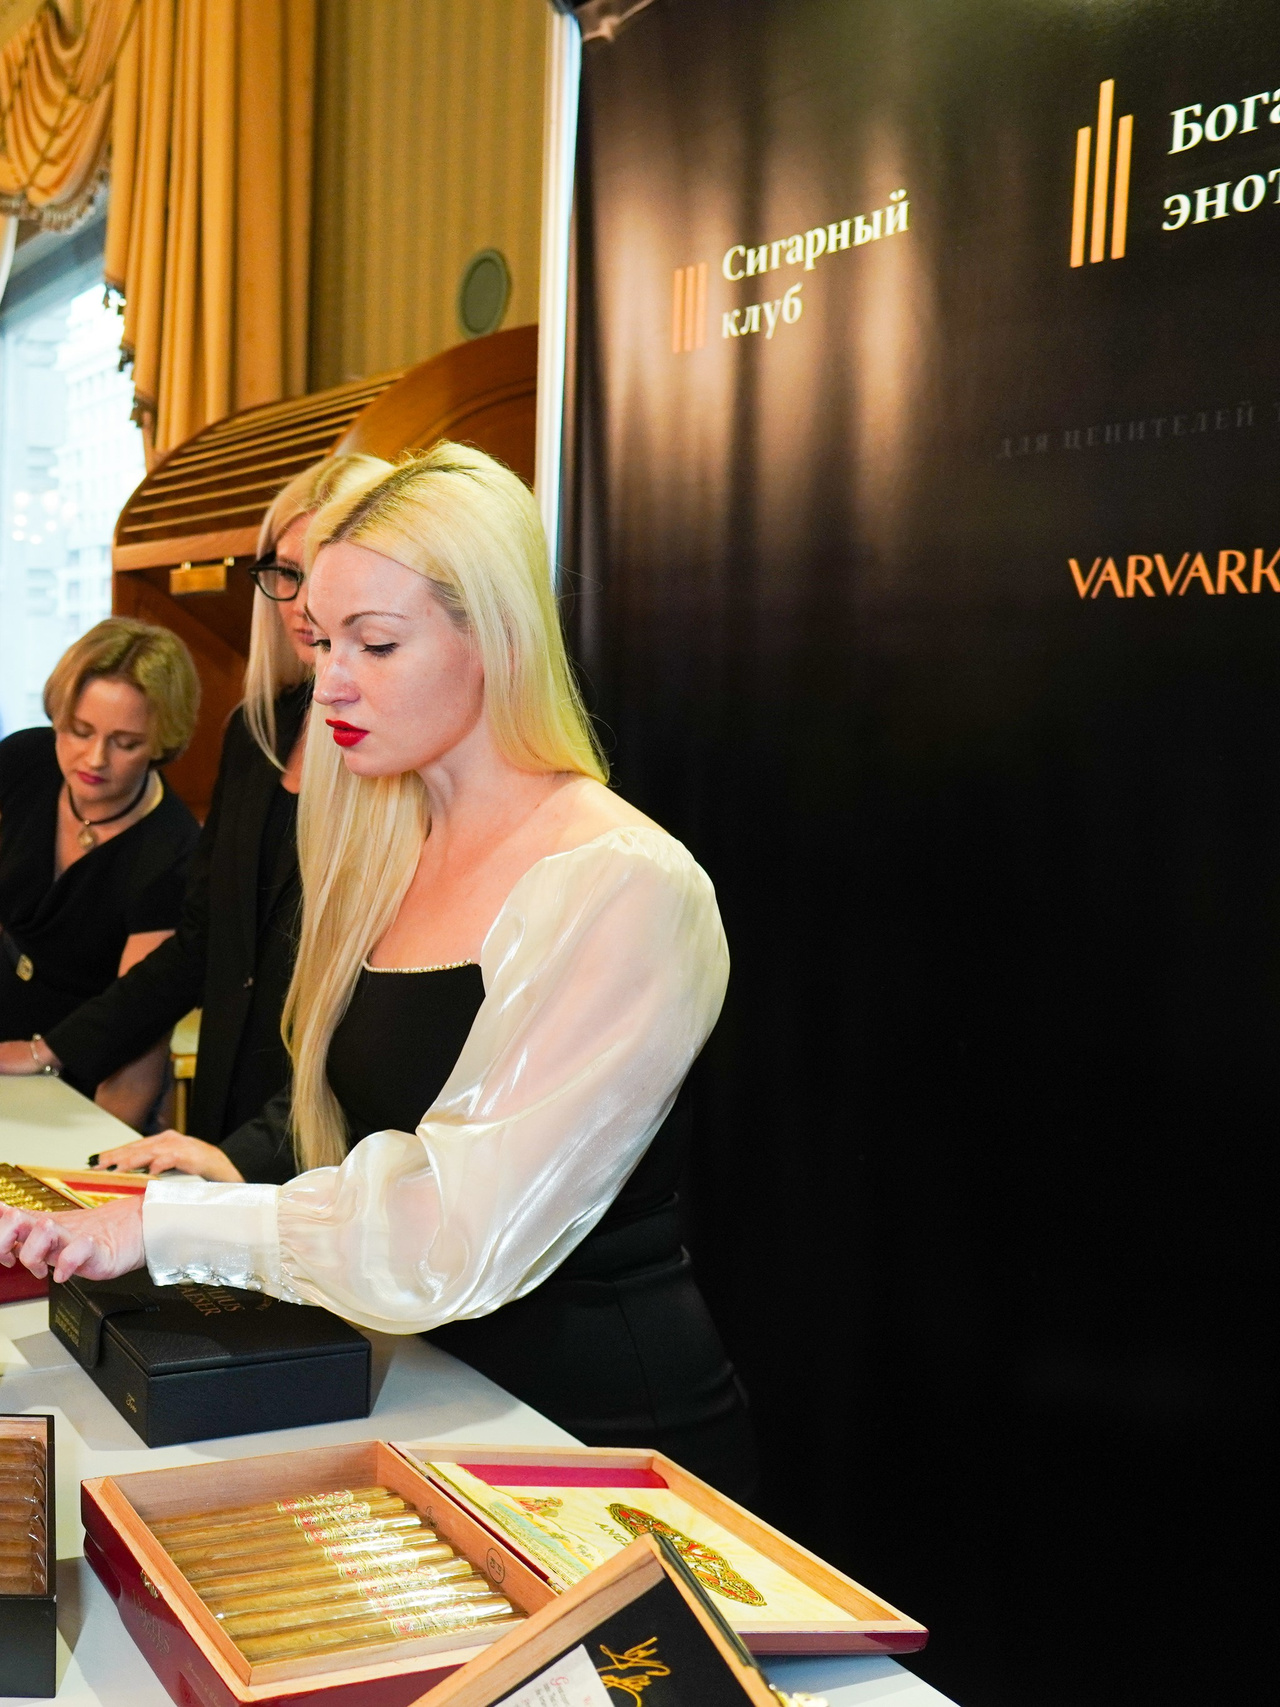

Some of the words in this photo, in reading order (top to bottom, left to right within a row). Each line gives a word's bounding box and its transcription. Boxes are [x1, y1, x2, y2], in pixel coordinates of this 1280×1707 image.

[721, 188, 911, 281] Сигарный
[721, 283, 803, 340] клуб
[1067, 547, 1280, 600] VARVARK
